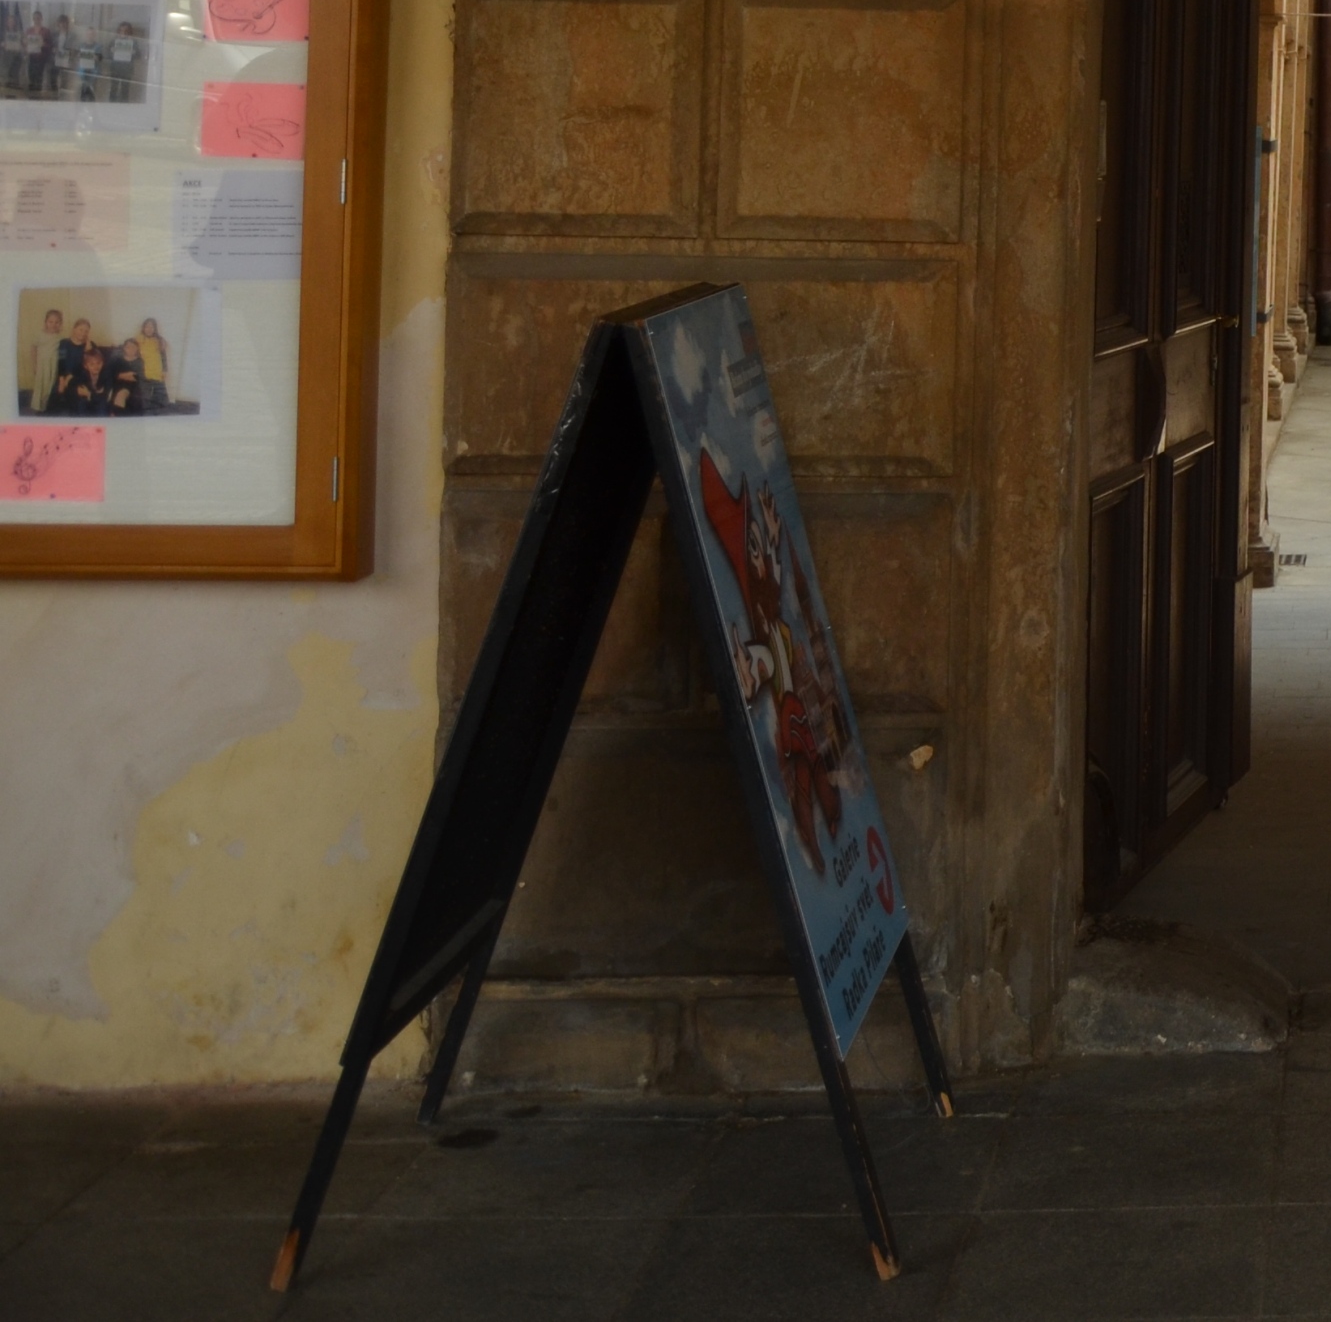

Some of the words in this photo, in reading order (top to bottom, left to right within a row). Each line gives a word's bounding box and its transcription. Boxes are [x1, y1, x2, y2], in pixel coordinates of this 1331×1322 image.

[832, 833, 861, 889] Galerie
[856, 875, 875, 922] svět
[842, 966, 869, 1022] Radka
